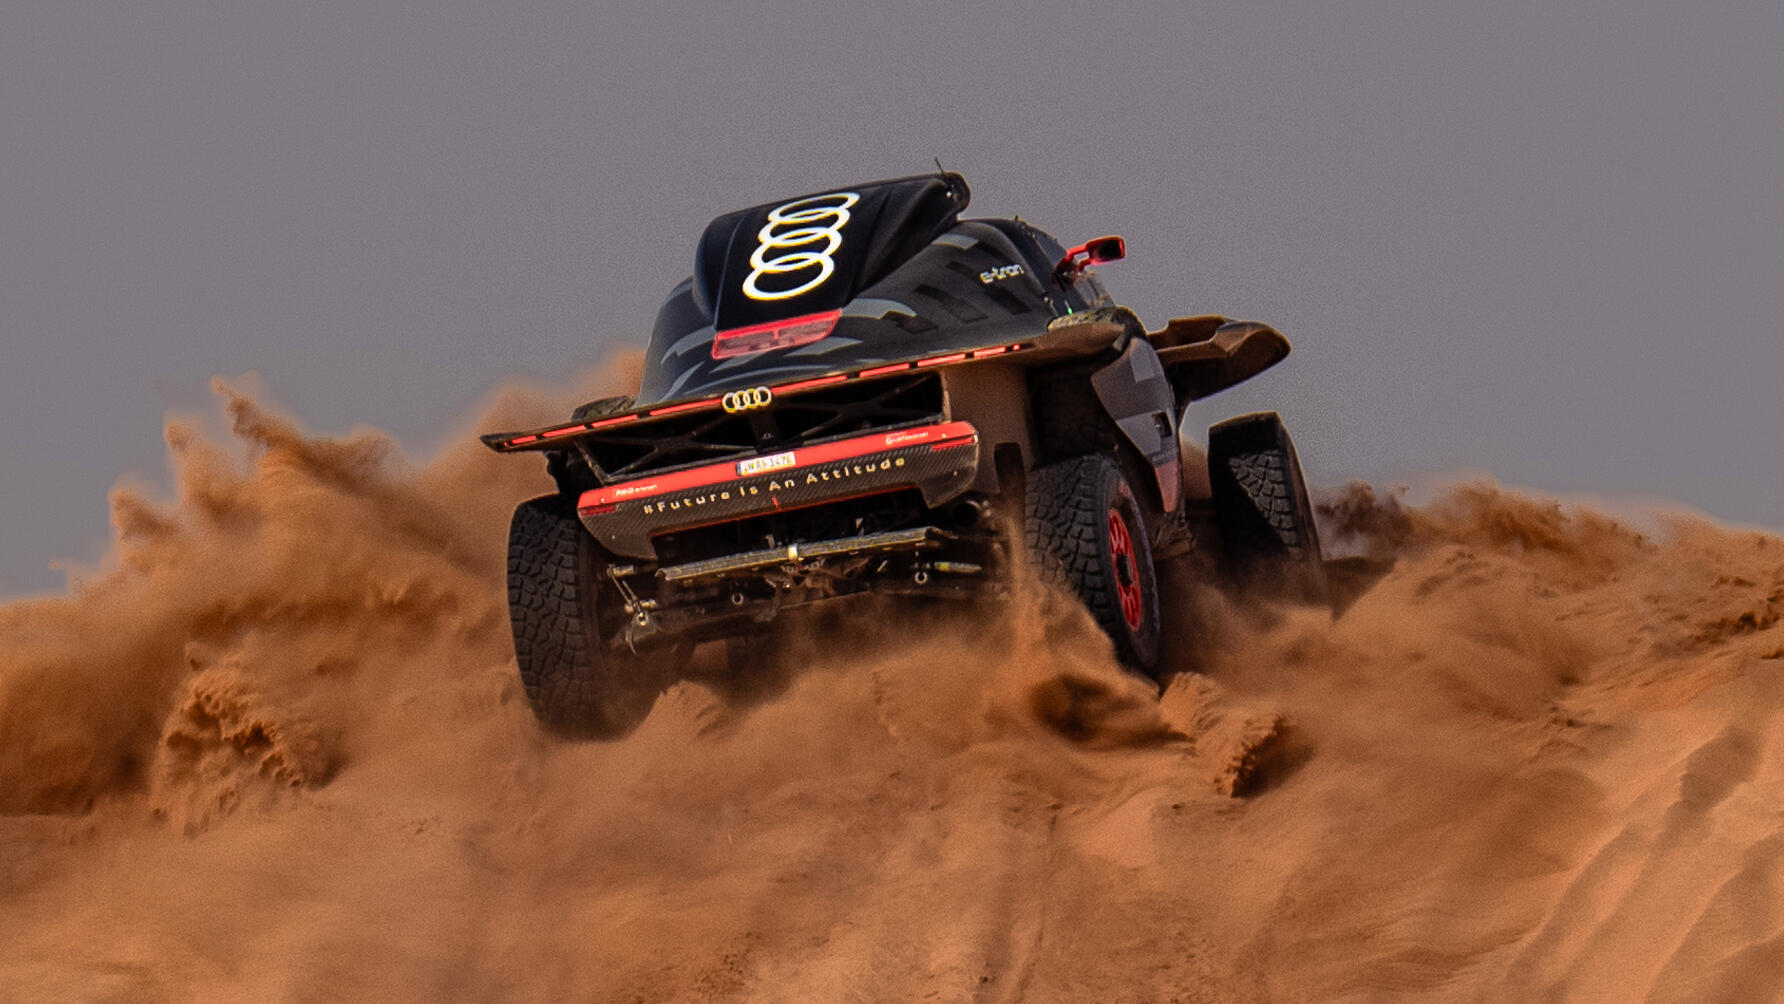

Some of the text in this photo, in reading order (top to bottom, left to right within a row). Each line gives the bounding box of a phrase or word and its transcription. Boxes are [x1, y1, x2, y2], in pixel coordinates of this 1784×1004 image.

[643, 492, 730, 514] #Future
[769, 480, 795, 492] An
[806, 458, 905, 485] Attitude
